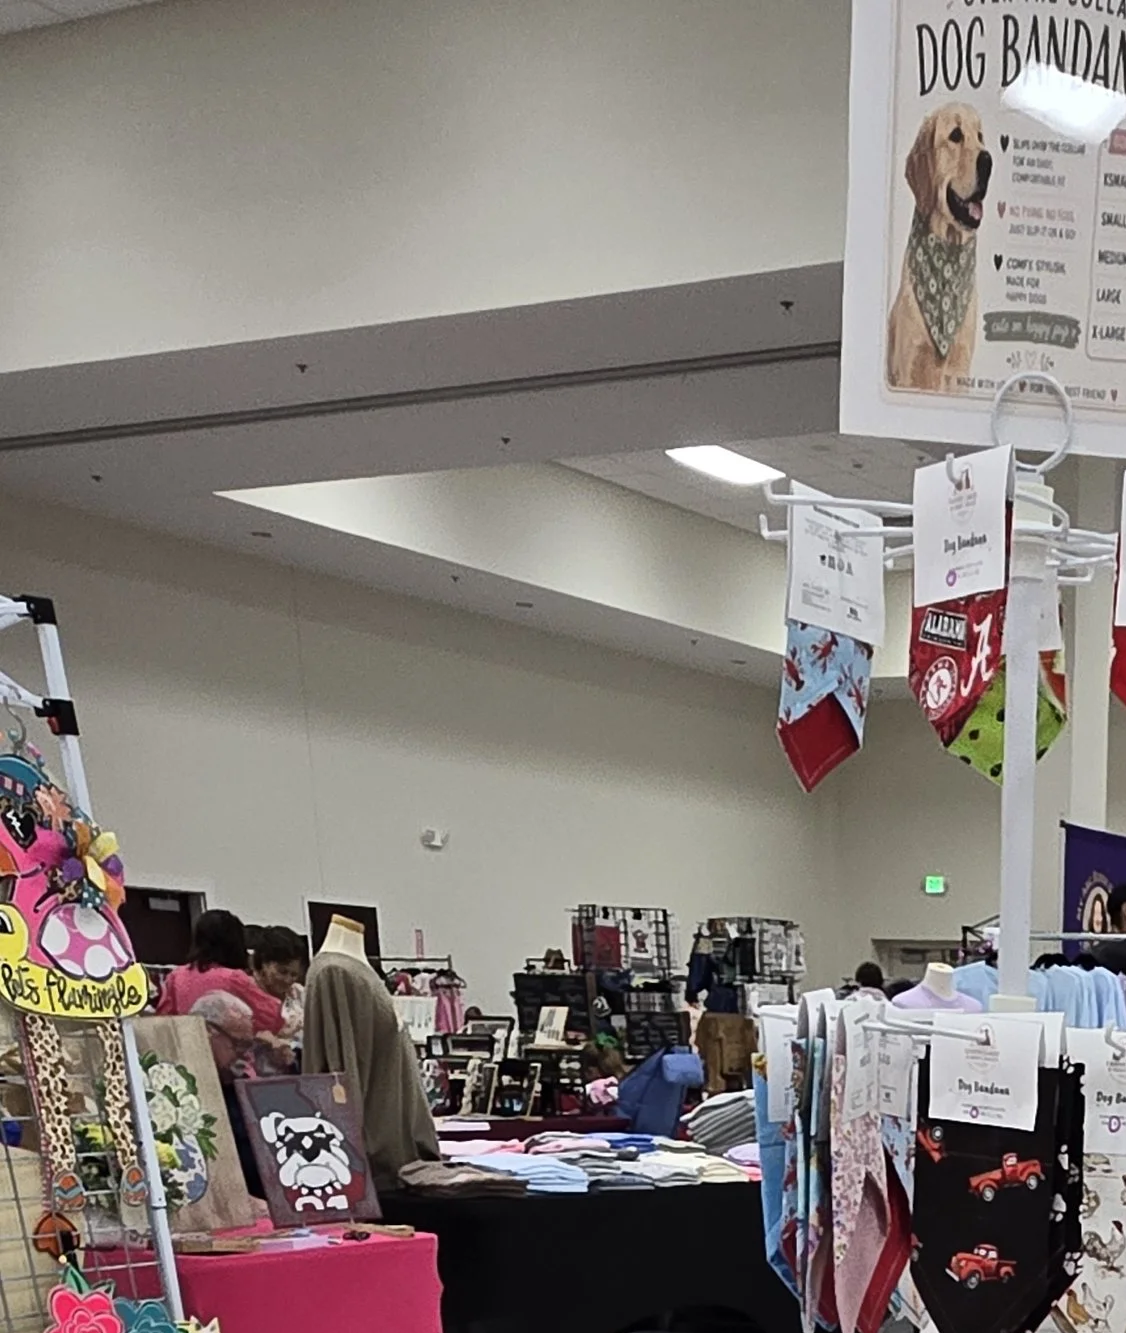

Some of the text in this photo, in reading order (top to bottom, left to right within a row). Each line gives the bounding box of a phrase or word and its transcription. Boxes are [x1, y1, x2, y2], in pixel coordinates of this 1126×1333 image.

[916, 16, 986, 97] DOG
[1101, 211, 1126, 229] SMALL
[1096, 288, 1122, 305] LARGE
[944, 531, 988, 556] Dog Bandana
[957, 1078, 1010, 1096] Dog Bandana
[1096, 1091, 1114, 1110] Dog
